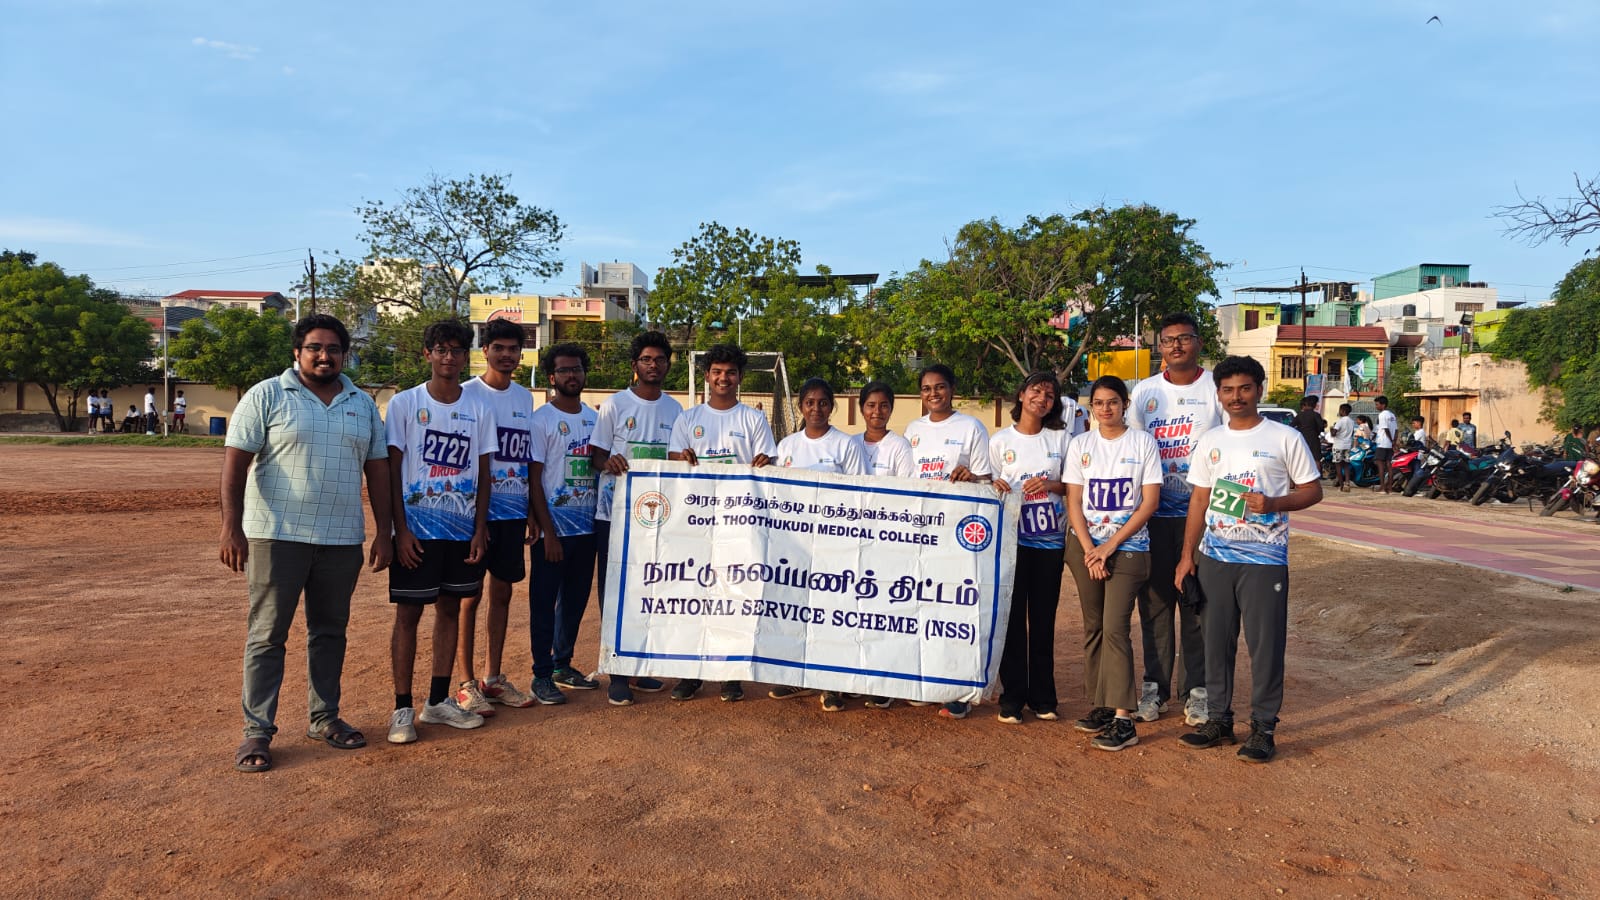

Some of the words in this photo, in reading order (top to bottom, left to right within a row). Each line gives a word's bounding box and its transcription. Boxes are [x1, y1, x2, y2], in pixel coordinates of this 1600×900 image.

[1154, 423, 1193, 439] RUN
[424, 434, 469, 466] 2727
[1159, 445, 1191, 460] RUGS
[921, 462, 944, 472] RUN
[1092, 481, 1134, 508] 1712
[1213, 489, 1242, 511] 27
[684, 493, 721, 508] அரசு
[723, 492, 805, 515] தூத்துக்குடி
[808, 502, 945, 528] மருத்துவக்கல்லூரி
[687, 514, 719, 526] Govt.
[722, 514, 814, 534] THOOTHUKUDI
[817, 523, 875, 540] MEDICAL
[878, 529, 939, 546] COLLEGE
[643, 557, 718, 588] நாட்டு
[726, 557, 879, 601] நலப்பணித்
[888, 575, 980, 606] திட்டம்
[640, 597, 736, 616] NATIONAL
[741, 599, 826, 625] SERVICE
[832, 609, 919, 635] SCHEME
[925, 619, 976, 646] (NSS)
